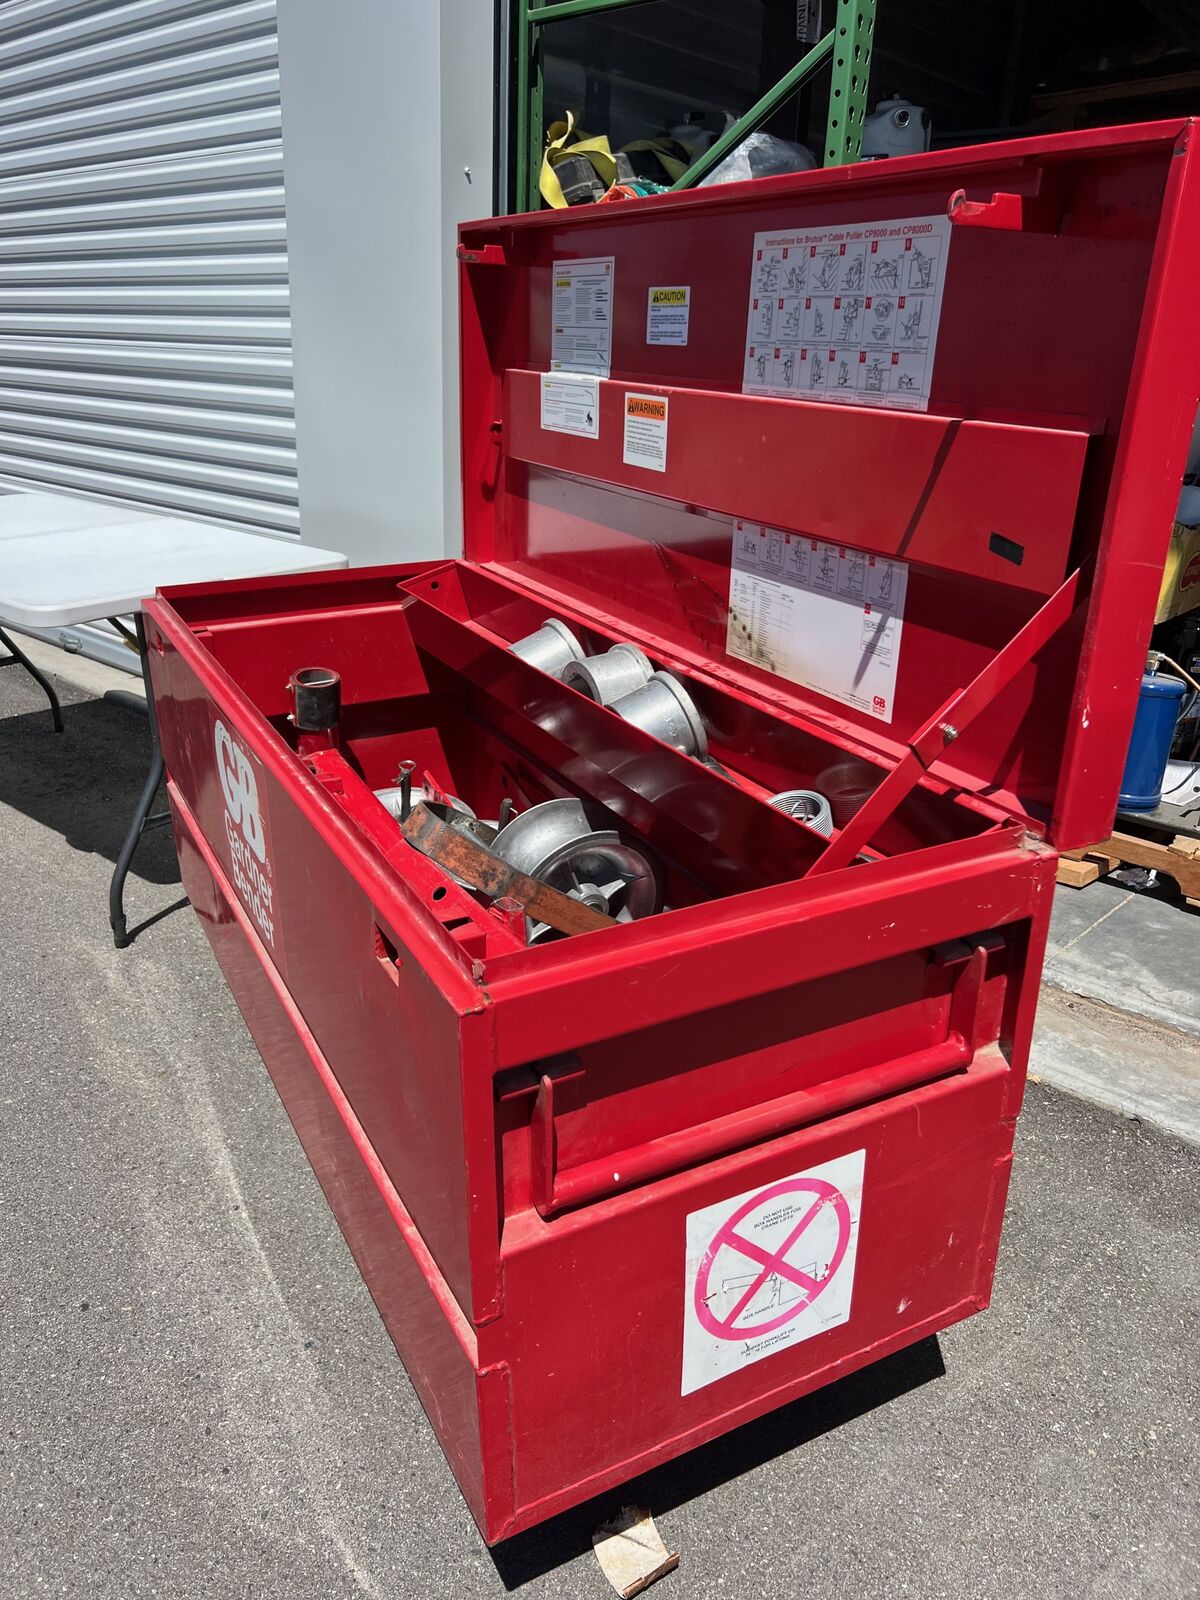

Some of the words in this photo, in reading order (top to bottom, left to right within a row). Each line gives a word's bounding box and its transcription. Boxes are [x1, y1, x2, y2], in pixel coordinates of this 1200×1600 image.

[766, 237, 795, 246] Instructions
[828, 232, 844, 242] Cable
[846, 231, 863, 240] Puller
[864, 228, 888, 238] CP8000
[888, 227, 902, 236] and
[902, 224, 933, 235] CP8000D
[659, 291, 686, 301] CAUTION
[634, 401, 665, 416] WARNING
[874, 696, 886, 708] GB
[214, 719, 266, 864] GB
[224, 809, 273, 914] Gardner
[231, 845, 275, 949] Bender
[761, 1220, 778, 1230] CRANE
[780, 1214, 794, 1222] LIFTS
[766, 1212, 790, 1223] HANDLES
[754, 1304, 774, 1315] HANDLE
[760, 1342, 772, 1350] FOR
[772, 1334, 790, 1344] LIFTING
[764, 1331, 788, 1344] FORKLIFT
